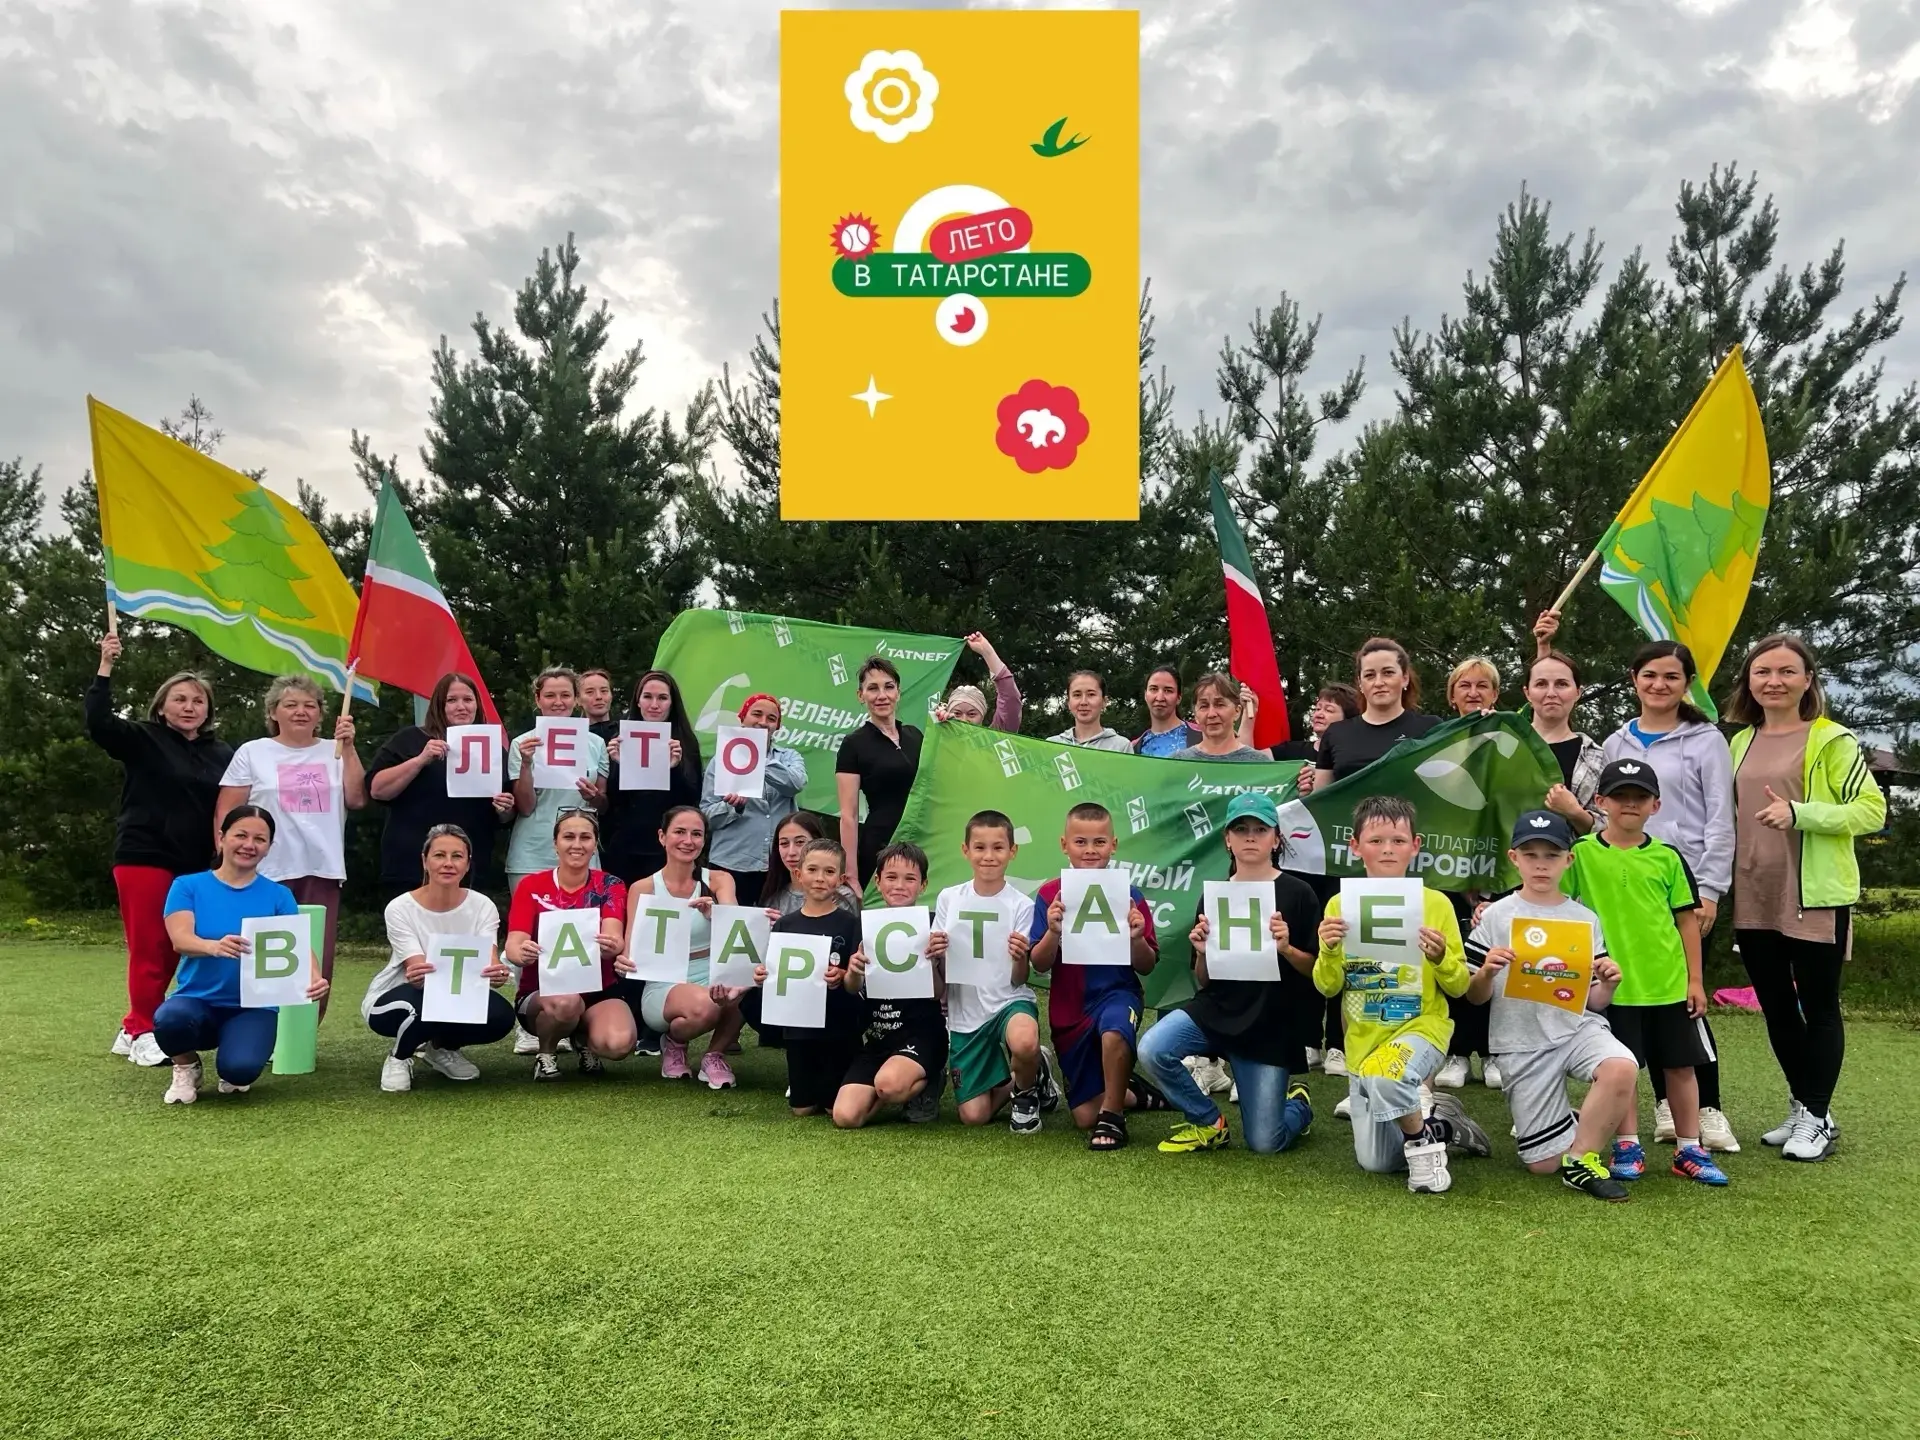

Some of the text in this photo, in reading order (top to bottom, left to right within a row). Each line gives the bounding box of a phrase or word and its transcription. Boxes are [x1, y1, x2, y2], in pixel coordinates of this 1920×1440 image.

[455, 736, 490, 774] Л
[548, 728, 577, 766] Е
[630, 732, 660, 768] Т
[723, 738, 759, 775] О
[772, 726, 846, 752] ФИТНЕ
[646, 909, 680, 954] Т
[1071, 885, 1120, 933] А
[1218, 897, 1262, 951] Н
[1360, 896, 1406, 946] Е
[255, 931, 299, 979] В
[548, 923, 592, 968] А
[718, 920, 762, 964] А
[875, 922, 918, 973] С
[959, 912, 998, 959] Т
[440, 949, 479, 995] Т
[777, 948, 815, 996] Р
